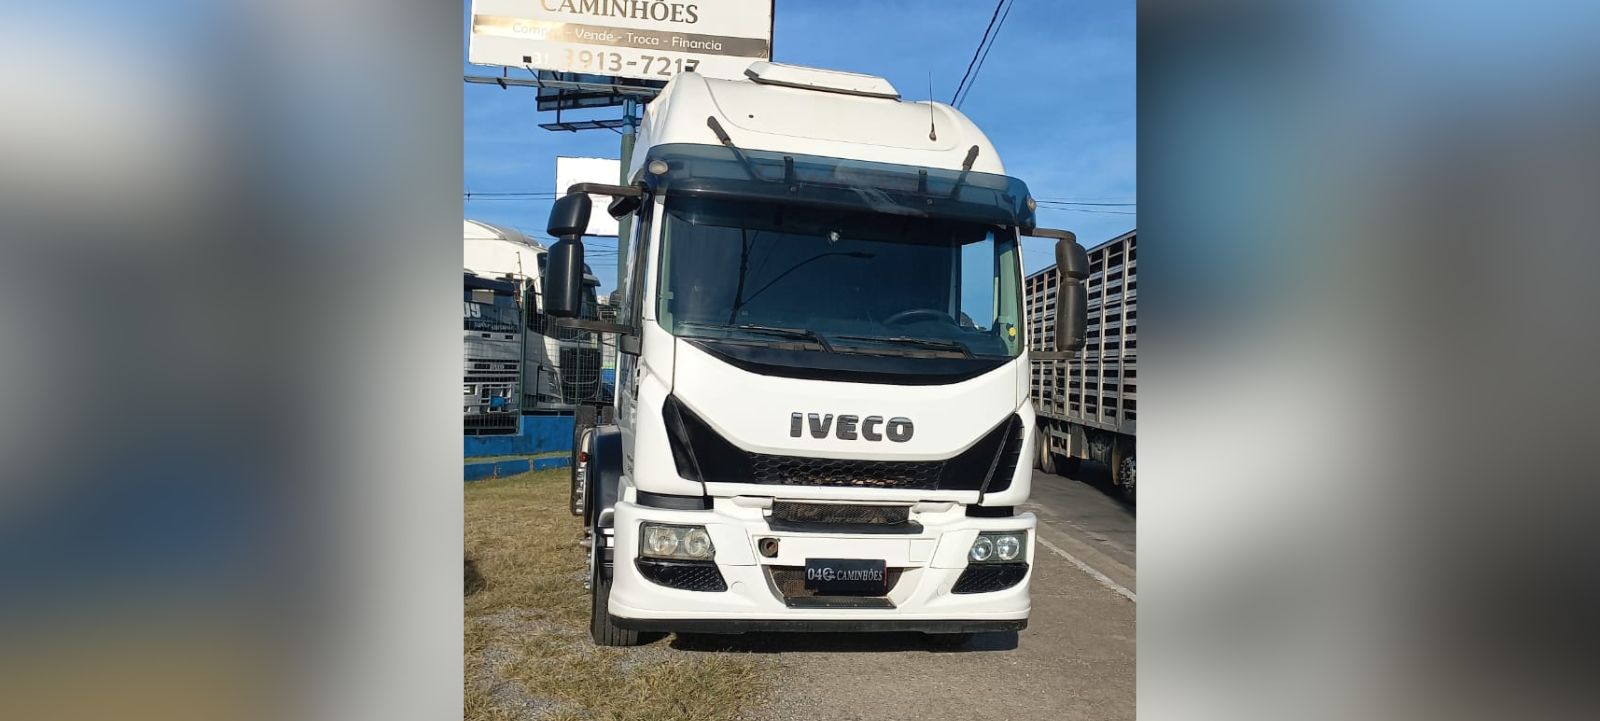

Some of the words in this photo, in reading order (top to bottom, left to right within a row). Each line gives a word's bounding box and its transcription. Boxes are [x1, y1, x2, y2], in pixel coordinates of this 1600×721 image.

[540, 0, 698, 24] CAMINHÕES
[575, 28, 614, 41] Vende
[626, 32, 660, 45] Troca
[672, 36, 722, 51] Financia
[790, 412, 914, 443] IVECO
